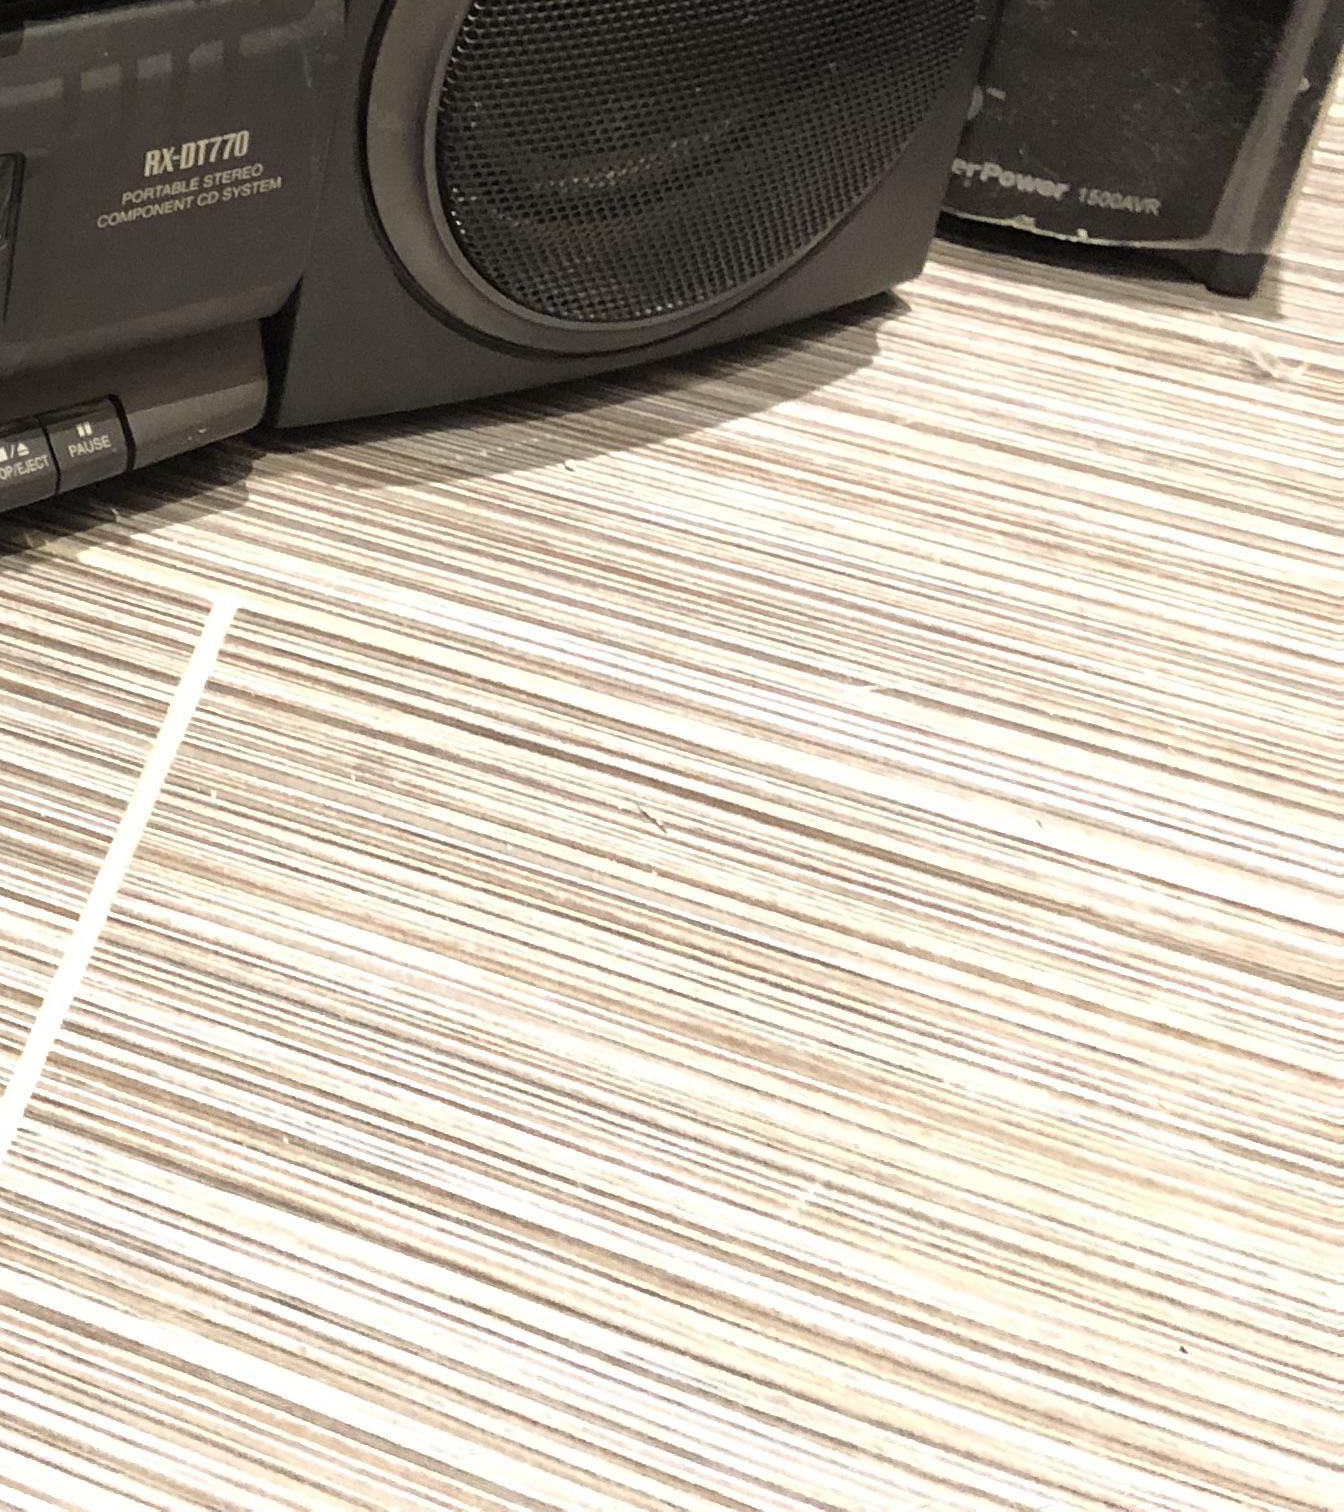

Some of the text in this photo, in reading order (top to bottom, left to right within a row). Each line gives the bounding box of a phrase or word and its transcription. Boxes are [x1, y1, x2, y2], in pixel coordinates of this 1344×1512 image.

[144, 129, 250, 177] RX-DT770
[121, 163, 264, 206] PORTABLE STEREO
[952, 158, 1070, 201] erPower
[97, 176, 282, 229] COMPONENT CD SYSTEM
[68, 434, 111, 458] PAUSE
